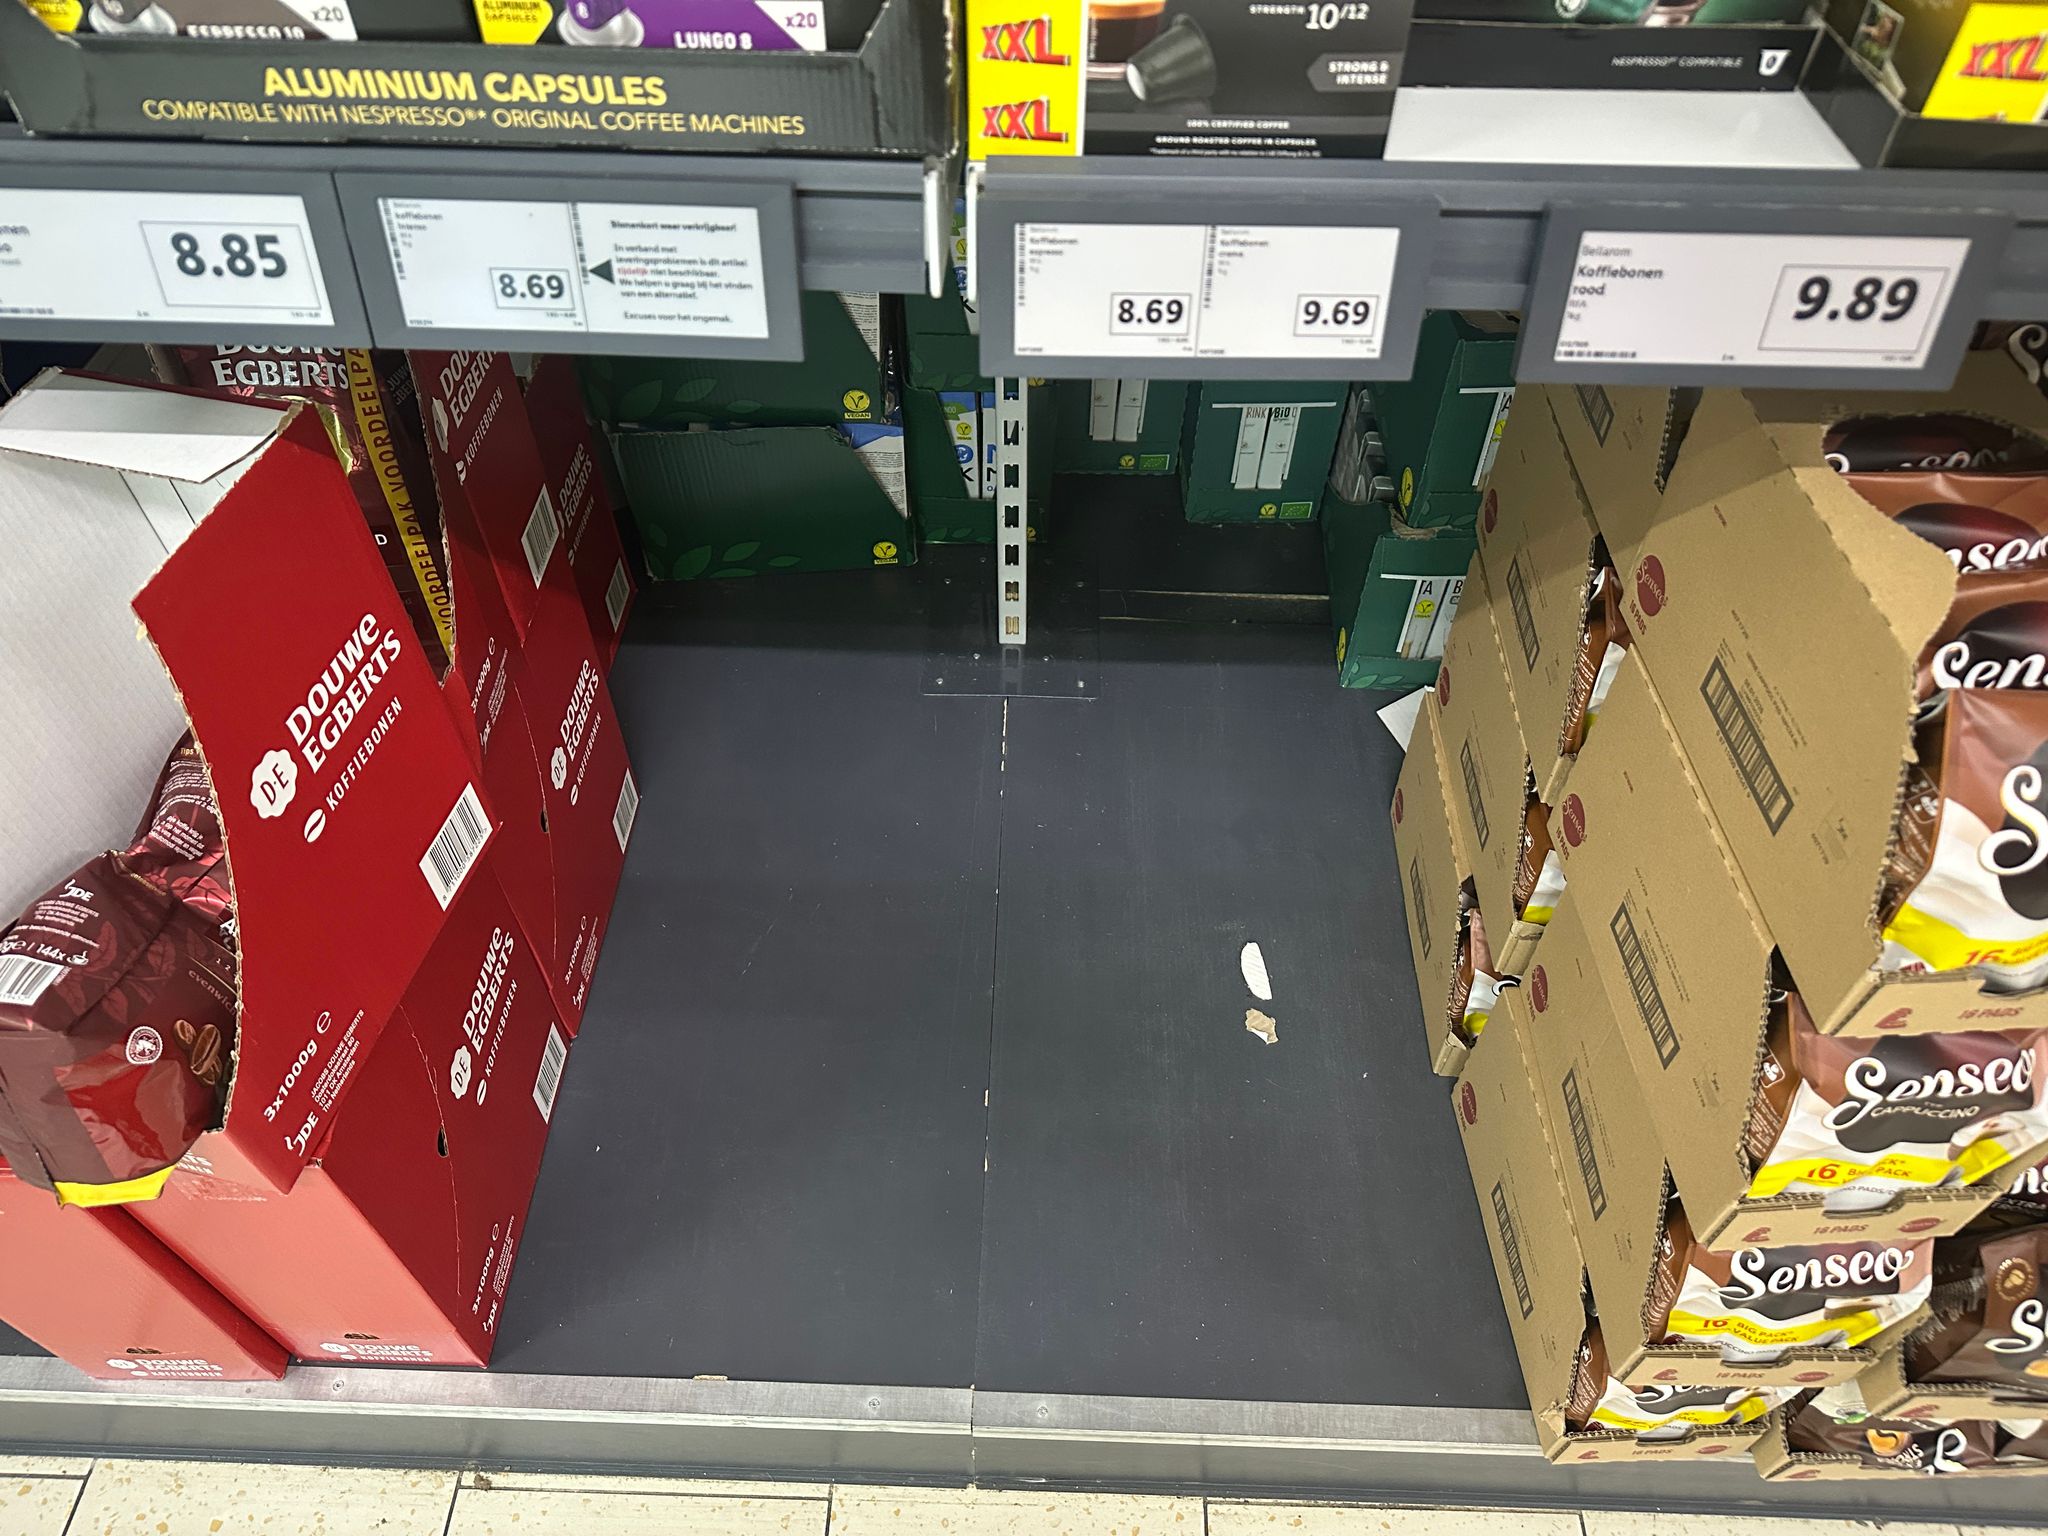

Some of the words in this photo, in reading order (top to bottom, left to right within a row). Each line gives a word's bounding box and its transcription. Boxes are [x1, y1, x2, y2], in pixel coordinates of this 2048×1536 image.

[311, 7, 344, 22] x20
[785, 12, 818, 29] x20
[1249, 5, 1306, 14] STRENGTH
[674, 31, 738, 50] LUNGO
[982, 15, 1070, 66] XXL
[1957, 35, 2048, 80] XXL
[1328, 61, 1378, 72] STRONG
[1336, 73, 1387, 85] INTENSE
[1679, 57, 1743, 68] COMPATIBLE
[264, 67, 478, 101] ALUMINIUM
[483, 72, 668, 106] CAPSULES
[142, 98, 279, 123] COMPATIBLE
[279, 103, 338, 123] WITH
[491, 107, 598, 130] ORIGINAL
[599, 110, 687, 132] COFFEE
[689, 113, 806, 136] MACHINES
[982, 96, 1068, 143] XXL
[1211, 120, 1255, 129] CERTIFIED
[1256, 121, 1290, 129] COFFEE
[1155, 135, 1190, 144] GROUND
[1192, 136, 1230, 145] ROASTED
[1231, 137, 1263, 145] COFFEE
[1275, 138, 1317, 146] CAPSULES
[171, 232, 287, 278] 8.85
[616, 256, 698, 267] leveringsproblemen
[625, 244, 660, 253] verband
[1582, 245, 1632, 257] Bellarom
[499, 273, 565, 299] 8.69
[634, 279, 663, 288] helpen
[672, 281, 695, 290] graag
[709, 281, 722, 289] het
[1573, 283, 1606, 295] rood
[1577, 266, 1664, 279] Koffiebonen
[624, 311, 656, 320] Excuses
[678, 313, 691, 321] het
[1118, 299, 1183, 324] 8.69
[1303, 300, 1370, 325] 9.69
[1793, 276, 1919, 323] 9.89
[210, 358, 349, 389] EGBERTS
[465, 386, 503, 467] KOFFIEBONEN
[559, 443, 584, 508] DOUWE
[563, 454, 592, 528] EGBERTS
[573, 496, 594, 552] KOFFIEBONEN
[1636, 560, 1666, 606] Senseo
[285, 613, 380, 746] DOUWE
[470, 657, 491, 714] 3x1000g
[301, 629, 401, 774] EGBERTS
[560, 659, 591, 744] DOUWE
[566, 669, 599, 762] EGBERTS
[325, 697, 402, 811] KOFFIEBONEN
[577, 712, 602, 786] KOFFIEBONEN
[37, 943, 66, 961] 144x
[564, 933, 583, 984] 3x1000g
[462, 926, 503, 1039] DOUWE
[471, 932, 514, 1055] EGBERTS
[485, 979, 518, 1078] KOFFIEBONEN
[311, 1069, 328, 1098] JACOBS
[327, 1040, 345, 1069] DOUWE
[344, 1010, 365, 1042] EGBERTS
[336, 1040, 360, 1078] Amsterdam
[264, 1039, 318, 1122] 3x1000g
[322, 1099, 333, 1113] The
[331, 1060, 356, 1100] Netherlands
[1822, 1048, 2036, 1131] Senseo
[1871, 1105, 1980, 1118] CAPPUCCINO
[1807, 1163, 1840, 1180] 16
[1830, 1224, 1869, 1233] PADS
[472, 1247, 494, 1314] 3x1000g
[1711, 1247, 1914, 1300] Senseo
[135, 1358, 203, 1367] DOUWE
[350, 1343, 420, 1352] DOUWE
[357, 1349, 433, 1357] EGBERTS
[138, 1364, 222, 1373] EGBERTS
